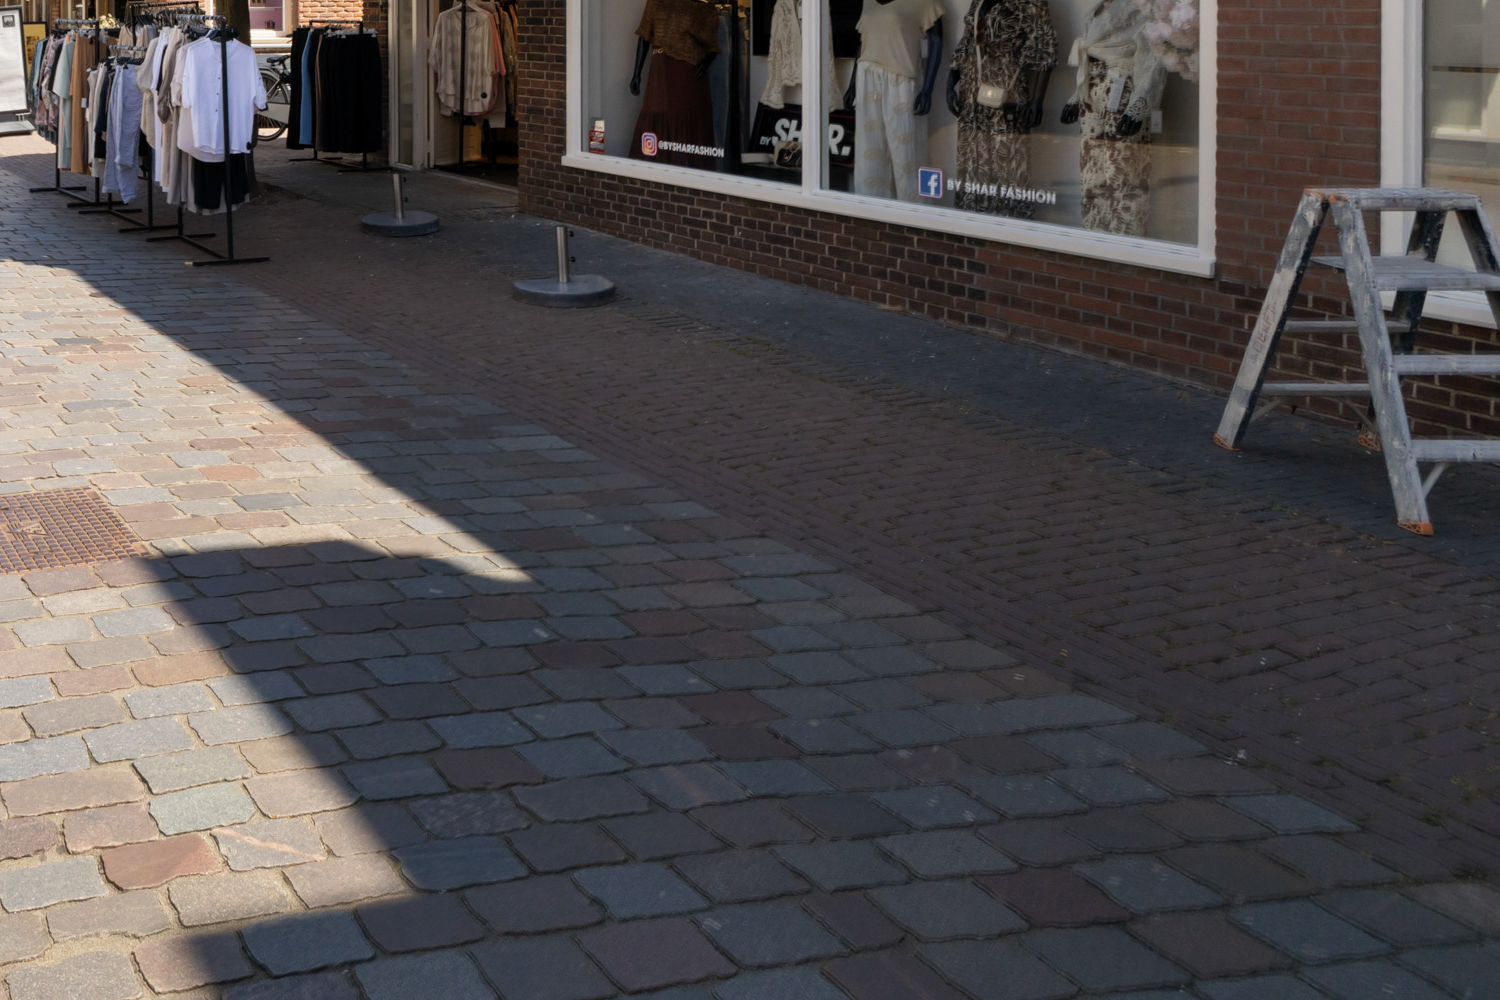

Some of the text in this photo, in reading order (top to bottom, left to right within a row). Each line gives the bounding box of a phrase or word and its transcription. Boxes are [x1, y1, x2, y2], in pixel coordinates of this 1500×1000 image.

[658, 140, 725, 158] @BYSHARFASHION
[759, 118, 851, 156] BY SHR.
[946, 179, 1056, 205] BY SHAR FASHION
